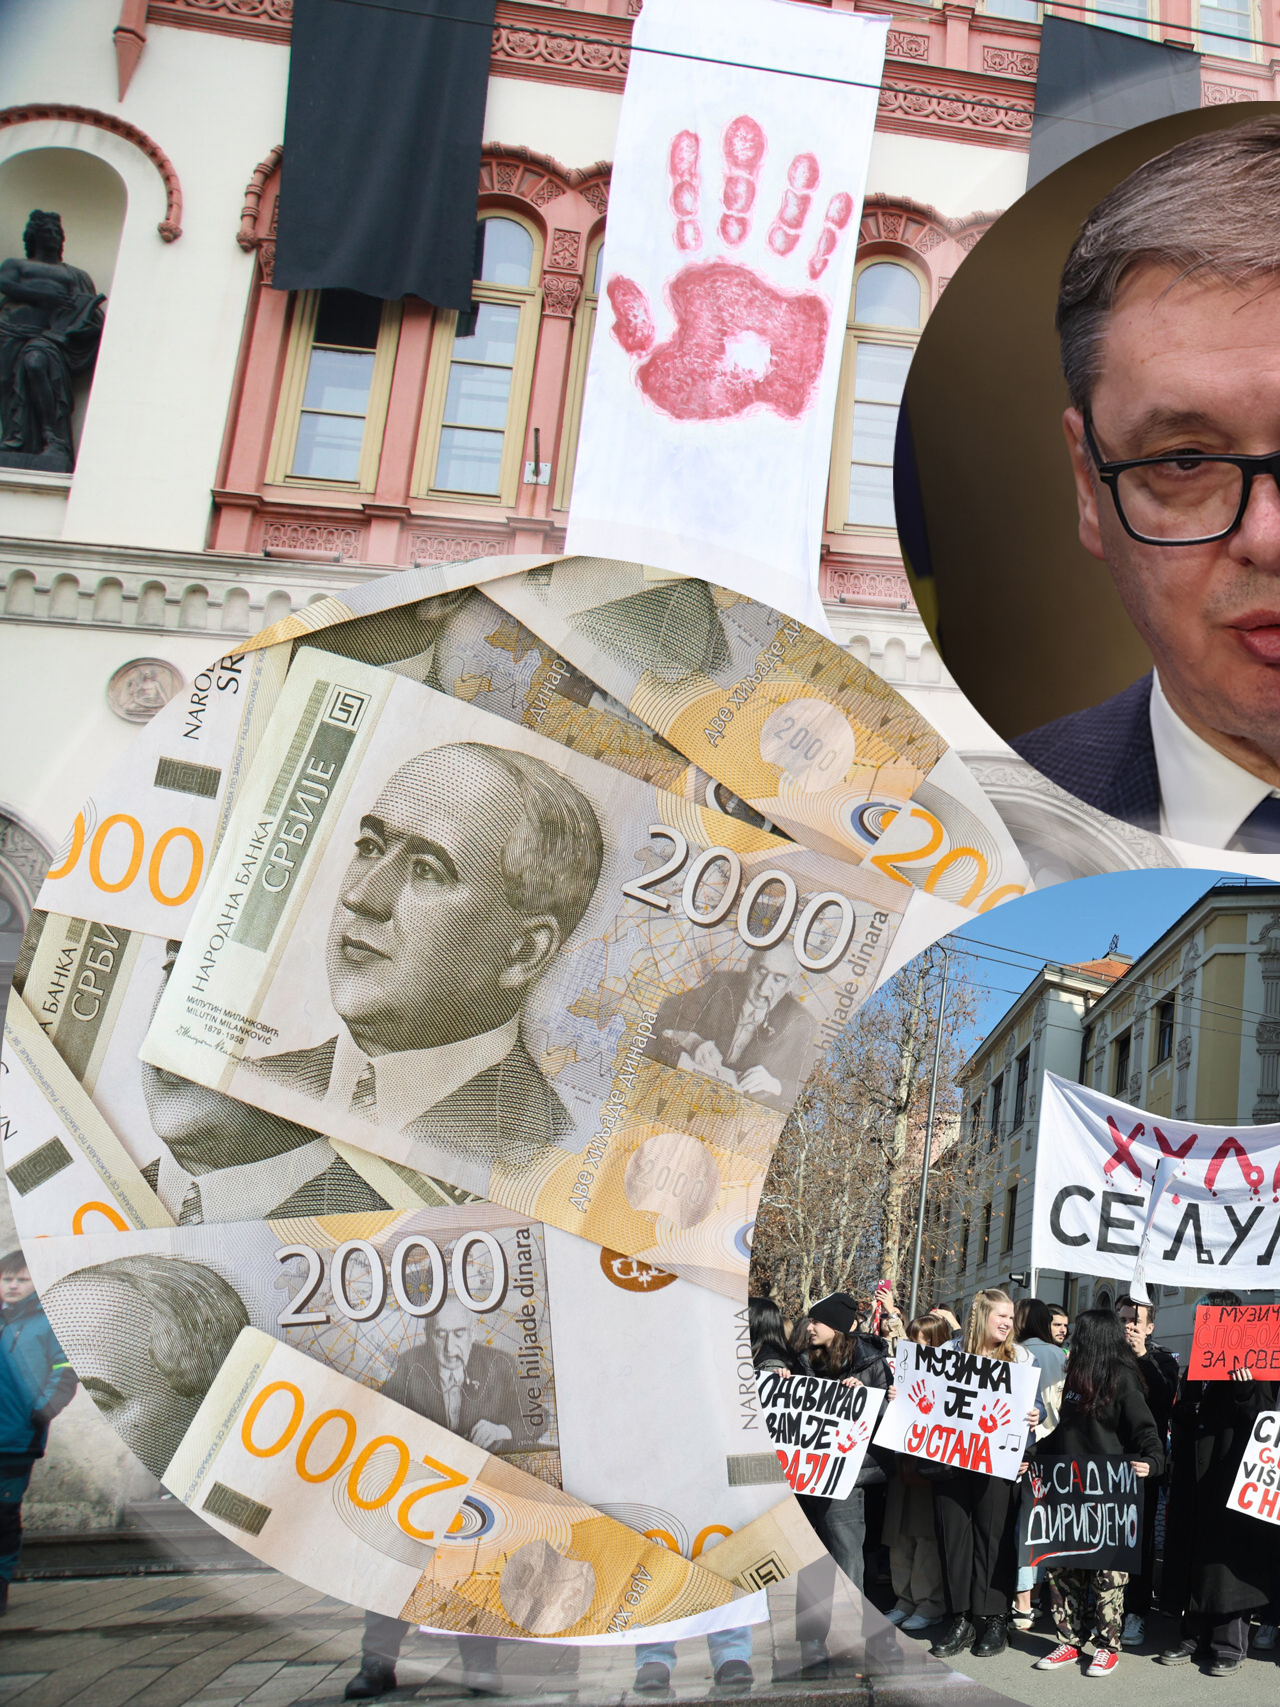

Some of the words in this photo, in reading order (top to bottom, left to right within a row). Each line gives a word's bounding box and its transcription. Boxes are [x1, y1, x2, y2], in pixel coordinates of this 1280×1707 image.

[774, 717, 837, 772] 2000
[262, 755, 337, 893] СРБИЈЕ
[192, 891, 243, 992] НАРОДНА
[235, 821, 273, 885] БАНКА
[620, 823, 856, 973] 2000
[848, 910, 889, 977] dinara
[42, 947, 77, 1015] БАНКА
[186, 995, 222, 1014] МИЛУТИН
[223, 1009, 279, 1038] МИЛАНКОВИЋ
[186, 1006, 218, 1023] MILUTIN
[219, 1018, 273, 1045] MILANKOVIĆ
[618, 1010, 658, 1090] динара
[640, 1159, 705, 1206] 2000
[1050, 1185, 1145, 1256] СЕ
[274, 1231, 509, 1328] 2000
[512, 1227, 535, 1298] dinara
[515, 1304, 544, 1380] hiljade
[733, 1307, 759, 1430] NARODNA
[915, 1344, 1012, 1394] МУЗИЧКА
[1201, 1350, 1226, 1368] ЗА
[523, 1387, 544, 1427] dve
[801, 1415, 838, 1450] ЈЕ
[944, 1385, 978, 1420] ЈЕ
[241, 1381, 470, 1540] 2000
